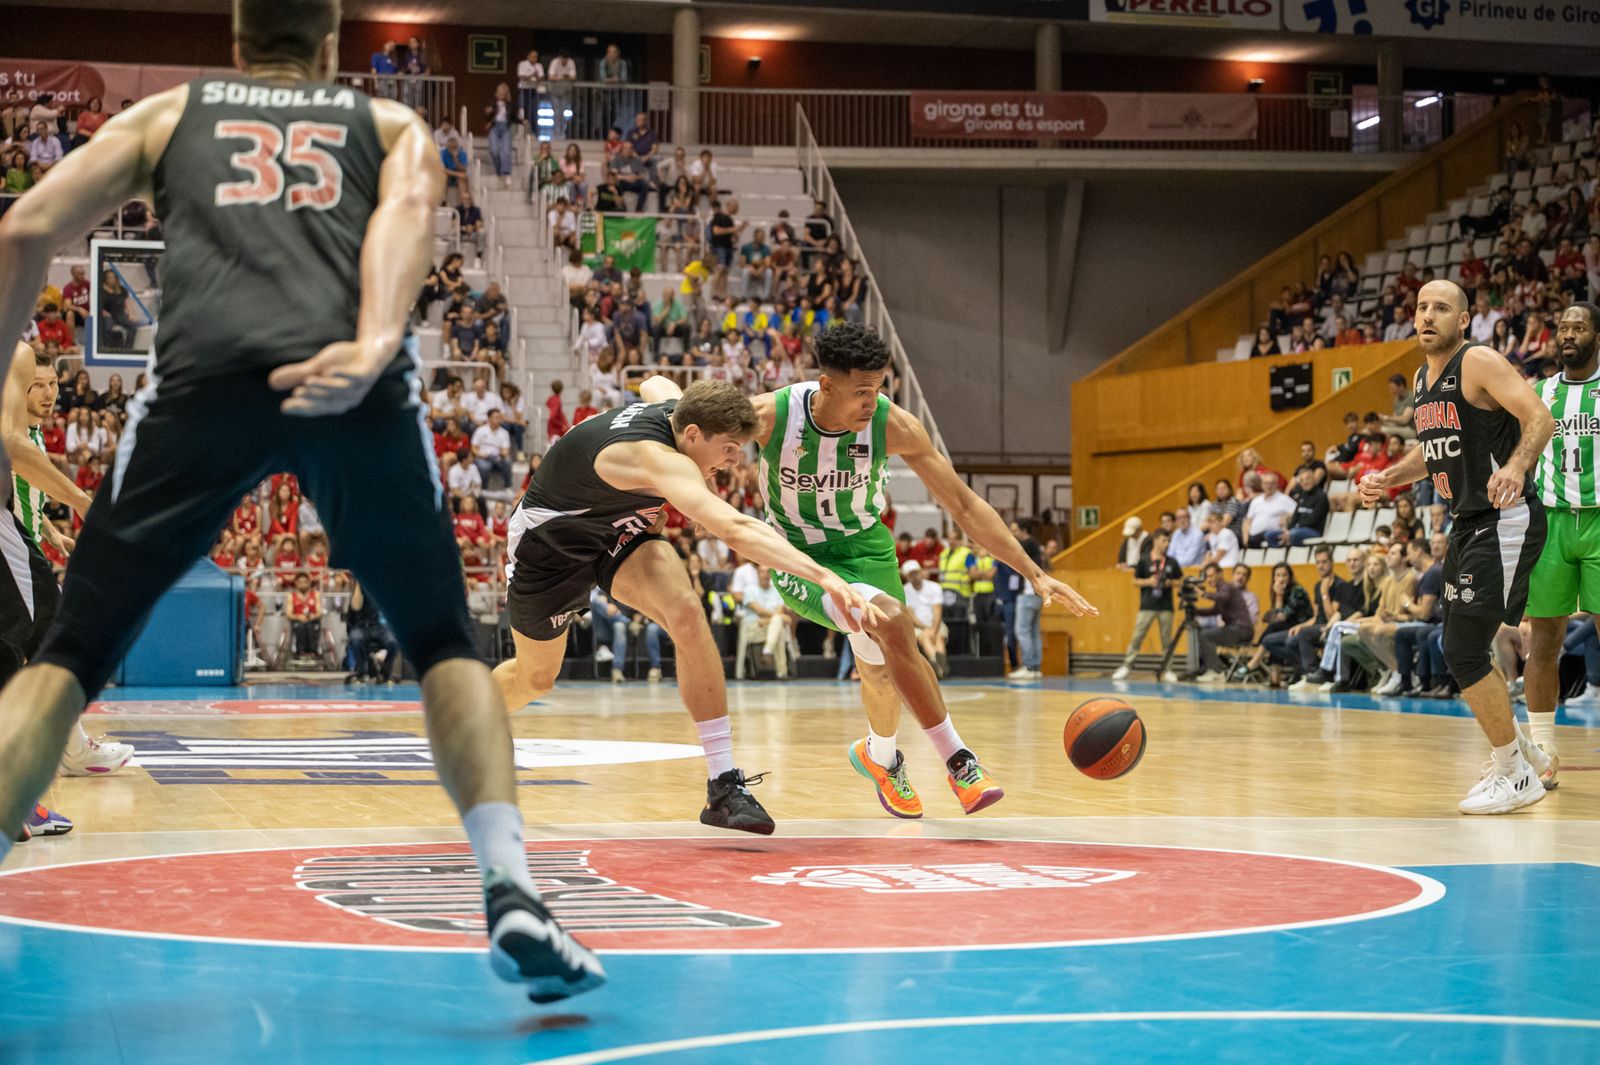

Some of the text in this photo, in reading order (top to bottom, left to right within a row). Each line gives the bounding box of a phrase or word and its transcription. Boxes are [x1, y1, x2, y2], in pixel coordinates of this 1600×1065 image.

[1460, 0, 1600, 24] Pirineu de Giro
[14, 70, 36, 87] tu
[201, 81, 355, 109] SOROLLA
[924, 100, 1044, 122] girona ets tu
[964, 116, 1085, 133] girona és esport
[214, 119, 348, 211] 35
[1554, 413, 1600, 430] evilla
[1561, 447, 1582, 473] 11
[780, 466, 863, 489] Sevilla
[820, 499, 833, 517] 1
